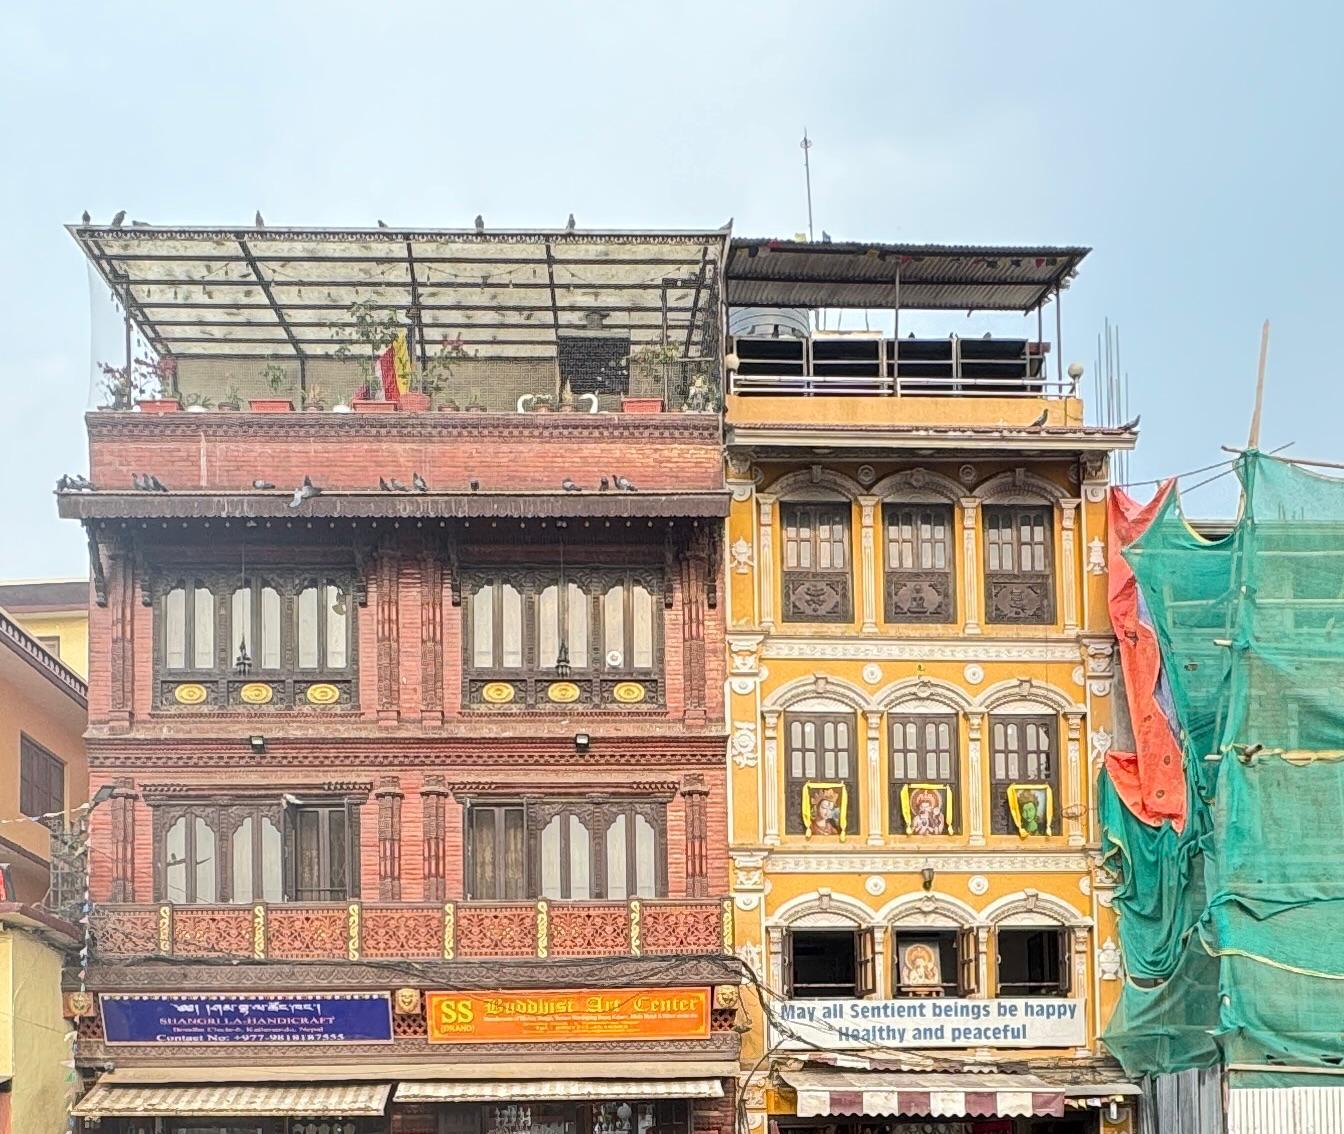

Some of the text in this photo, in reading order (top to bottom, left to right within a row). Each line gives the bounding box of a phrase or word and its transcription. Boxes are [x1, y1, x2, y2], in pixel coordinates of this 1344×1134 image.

[440, 999, 475, 1025] SS
[485, 996, 698, 1016] Buddhist Art Center
[781, 1001, 1077, 1022] May all Sentient beings be happy
[156, 1034, 203, 1042] Contact
[838, 1024, 1028, 1043] Healthy and peaceful
